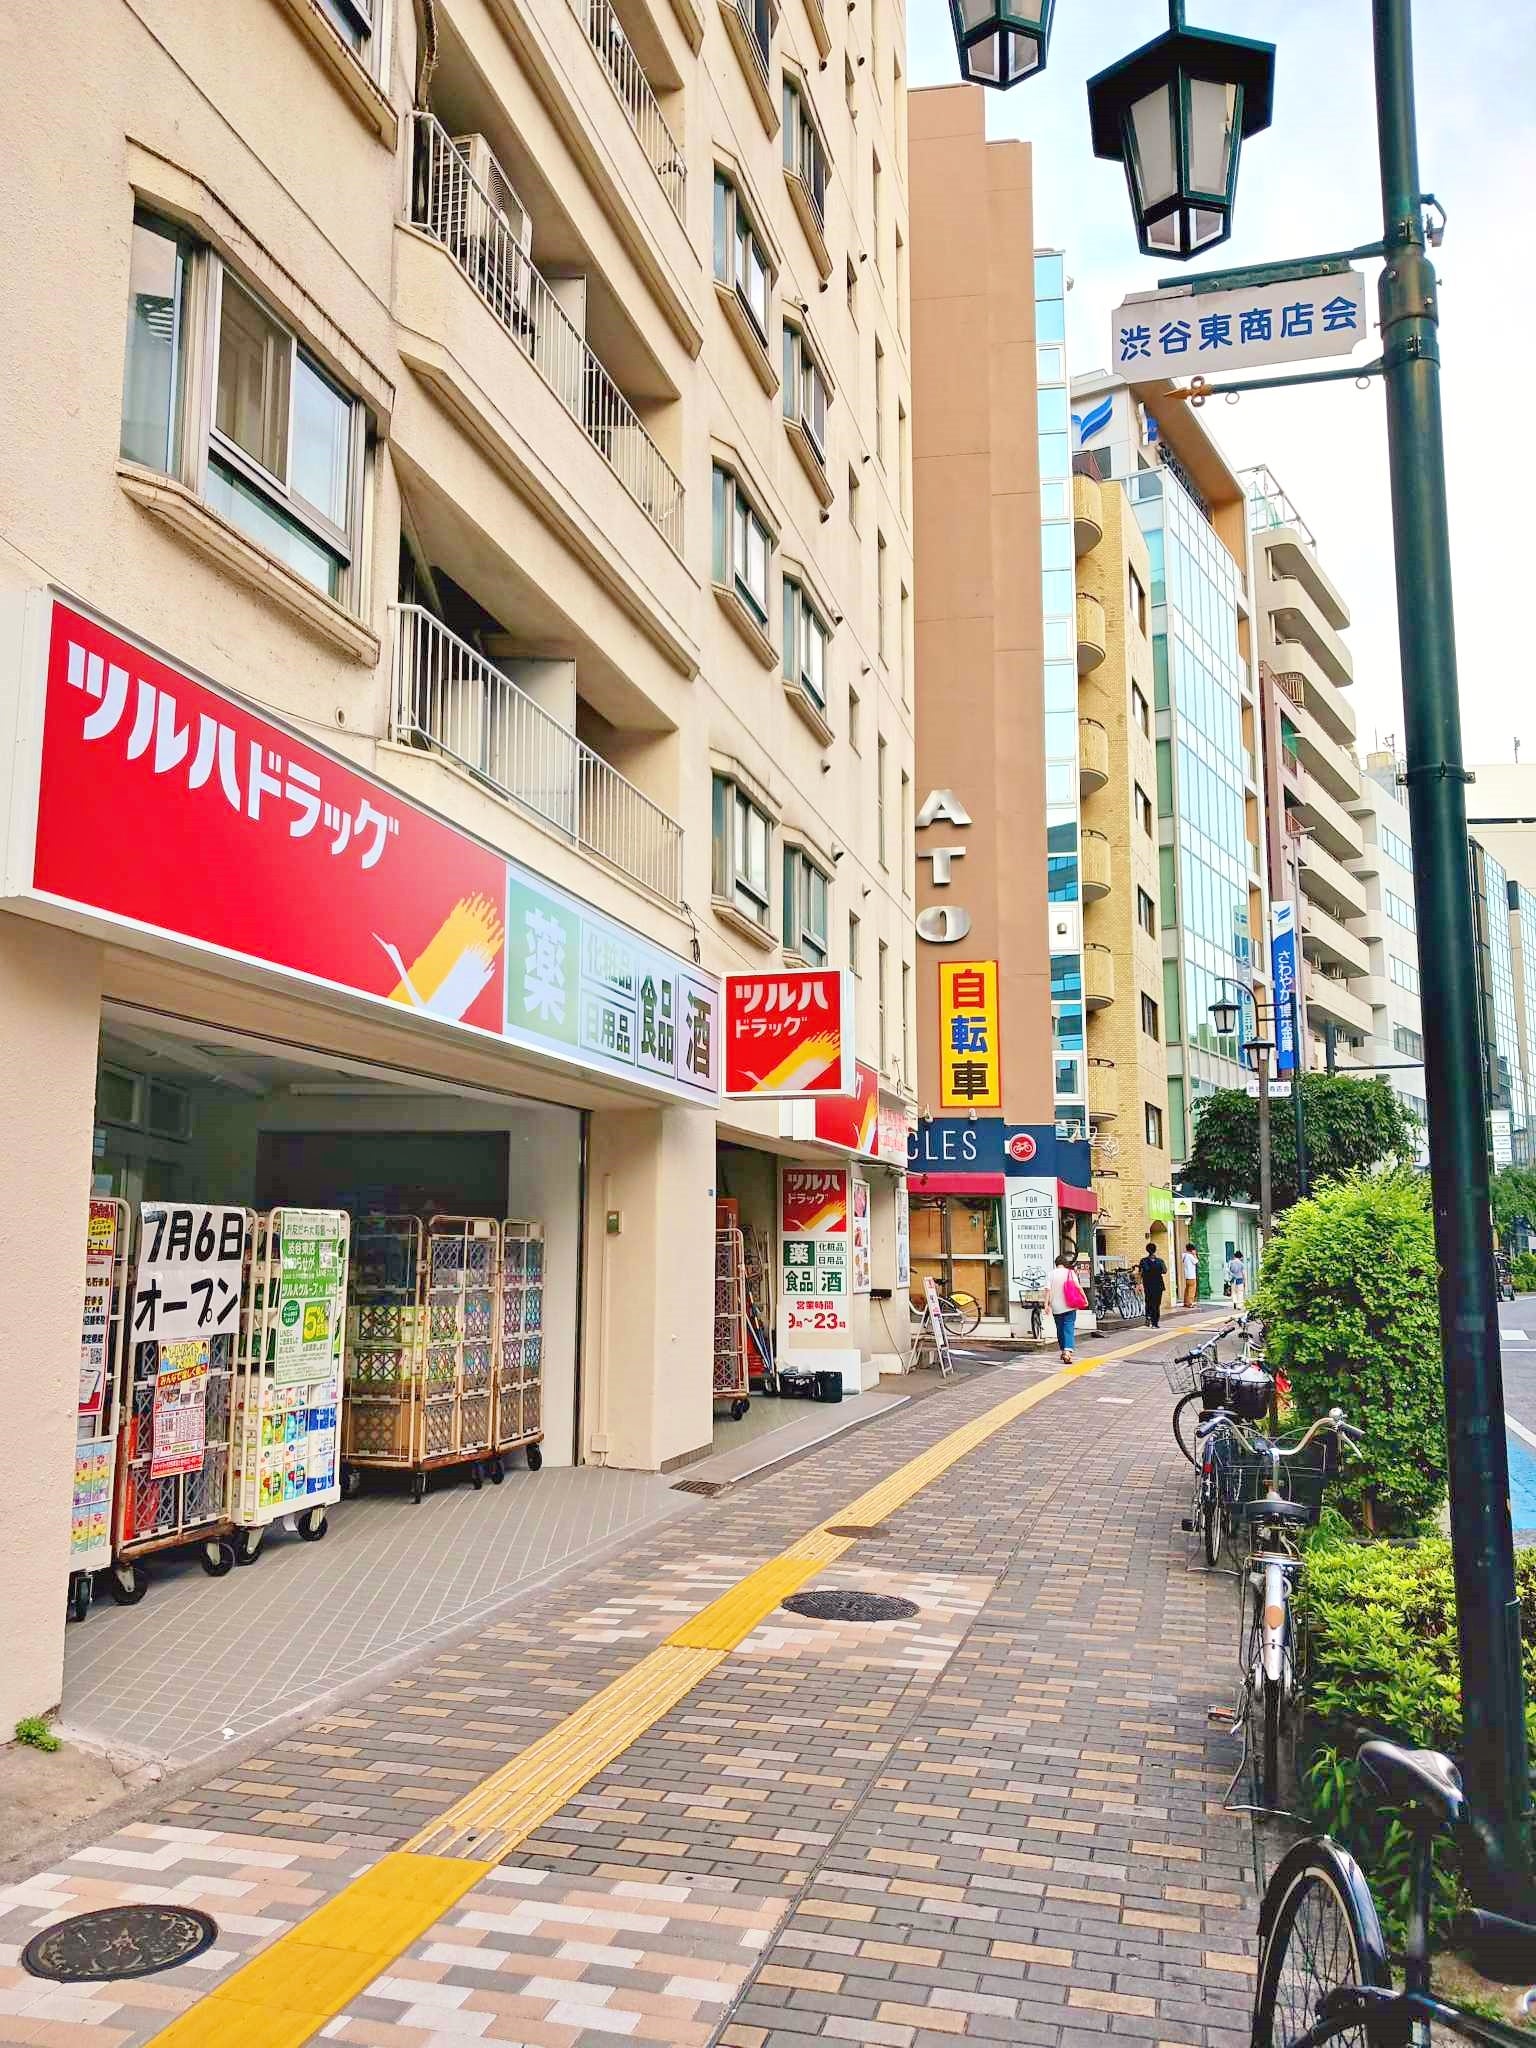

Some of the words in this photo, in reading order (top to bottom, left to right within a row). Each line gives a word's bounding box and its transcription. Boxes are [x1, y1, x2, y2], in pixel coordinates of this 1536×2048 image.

[1120, 295, 1357, 362] 渋谷東商店会
[66, 639, 400, 870] ツルハドラッグ
[524, 907, 567, 1025] 薬
[735, 981, 829, 1014] ツルハ
[586, 1000, 631, 1056] 日用品
[641, 974, 675, 1066] 食品
[735, 1016, 808, 1039] ドラッグ
[686, 989, 711, 1079] 酒
[951, 968, 989, 1100] 自転車
[787, 1174, 841, 1192] ツルハ
[788, 1193, 829, 1205] ドラッグ
[1025, 1196, 1038, 1204] FOR
[1011, 1209, 1035, 1218] DAILY
[1037, 1207, 1053, 1217] USE
[144, 1209, 244, 1263] 7月6日
[818, 1242, 844, 1252] 化粧品
[789, 1243, 809, 1265] 薬
[818, 1256, 844, 1265] 日用品
[785, 1270, 814, 1292] 食品
[821, 1271, 842, 1292] 酒
[134, 1278, 239, 1331] オープン
[796, 1301, 834, 1310] 営業時間
